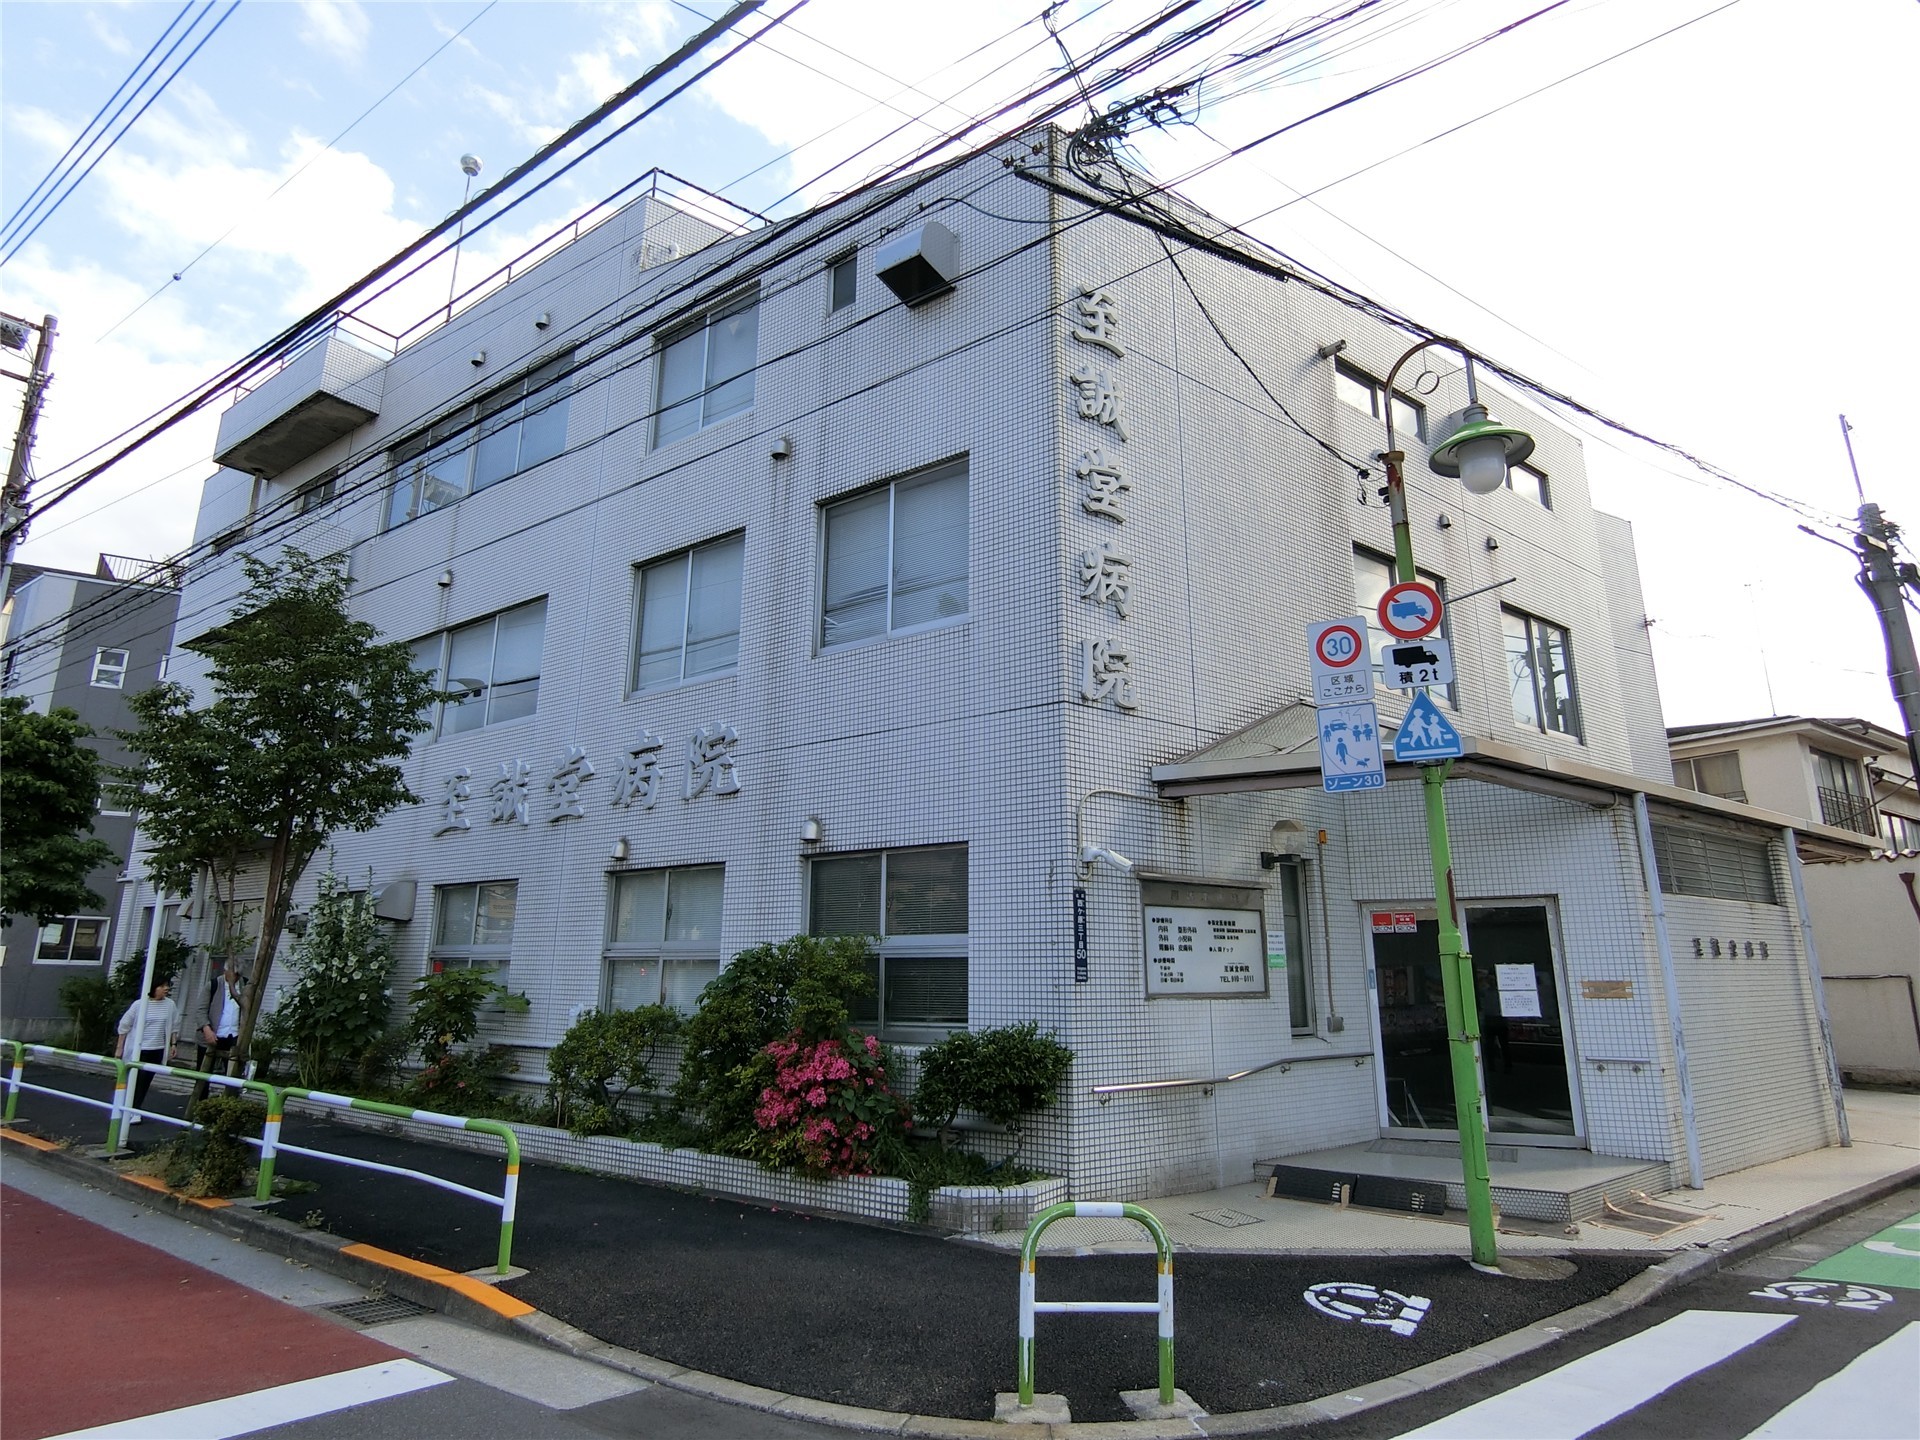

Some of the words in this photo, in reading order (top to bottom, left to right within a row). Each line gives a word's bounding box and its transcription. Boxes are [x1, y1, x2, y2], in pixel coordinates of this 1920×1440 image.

[1071, 283, 1140, 709] 至誠堂病院
[1326, 636, 1352, 657] 30
[1331, 674, 1354, 686] 区域
[1323, 685, 1365, 697] ここから
[433, 720, 741, 837] 至誠堂病院
[1327, 775, 1381, 790] ゾーン30
[1158, 925, 1168, 933] 内科
[1158, 934, 1169, 942] 外科
[1076, 949, 1086, 959] 50
[1220, 975, 1231, 983] TEL
